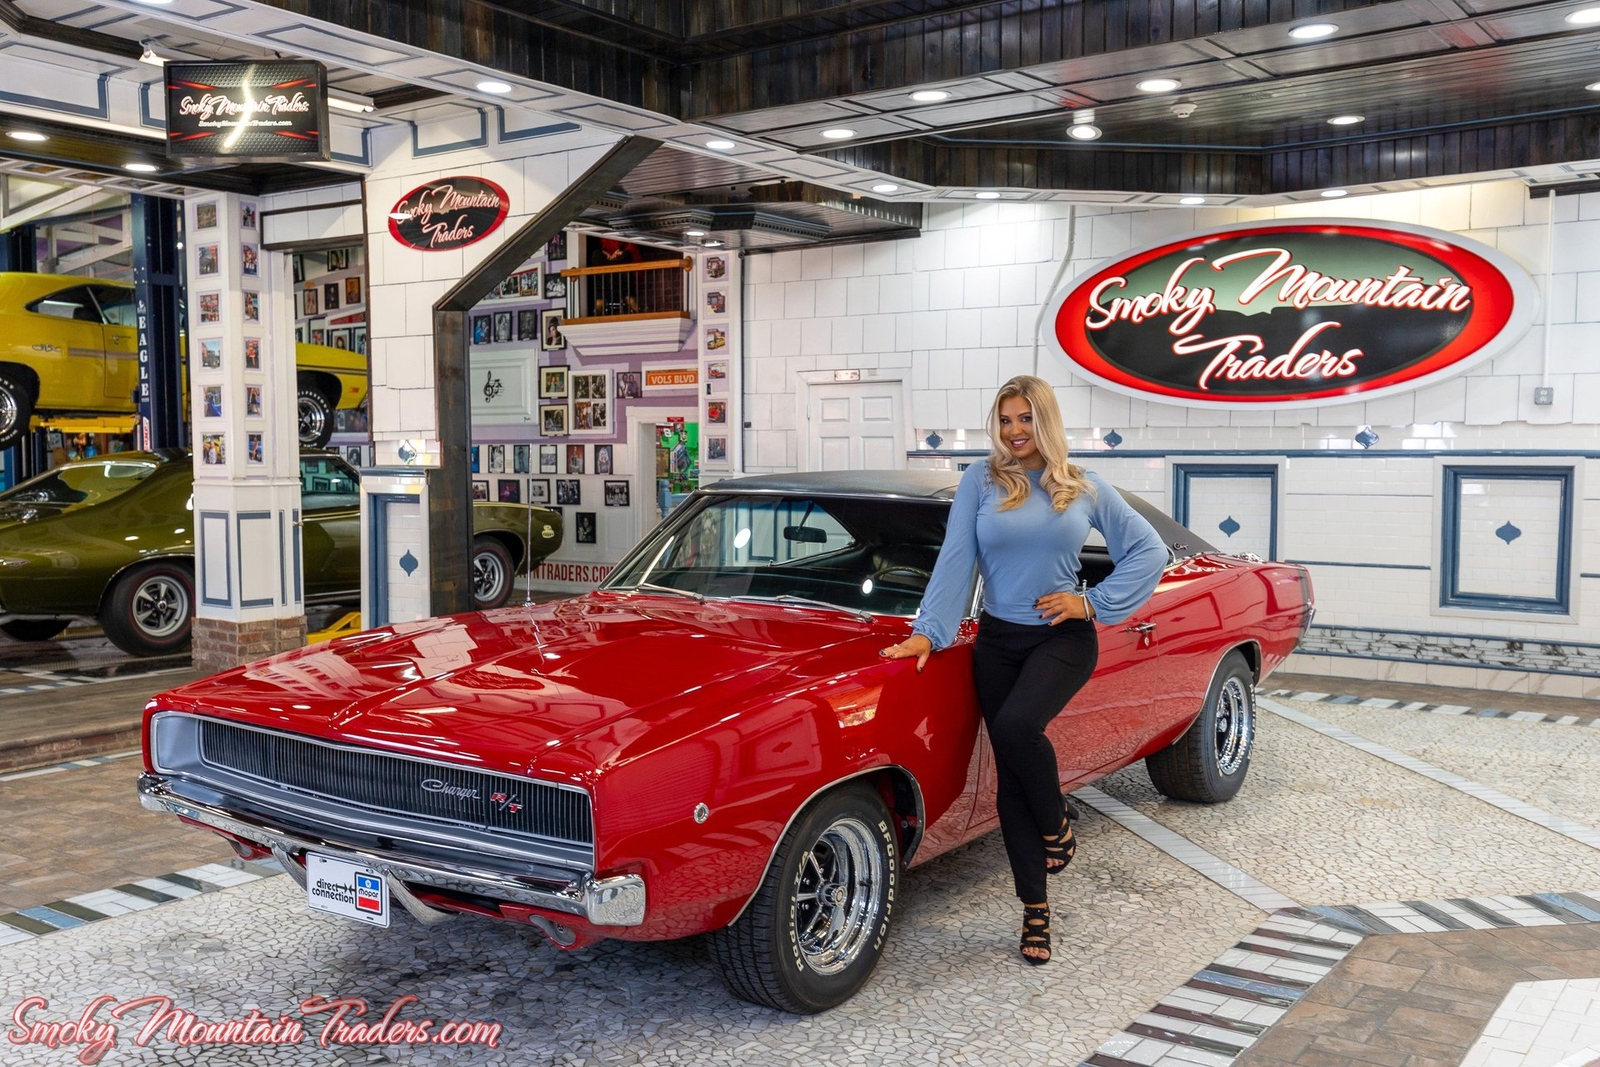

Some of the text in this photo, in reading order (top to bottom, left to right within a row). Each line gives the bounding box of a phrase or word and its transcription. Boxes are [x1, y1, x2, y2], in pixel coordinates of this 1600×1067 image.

[179, 91, 310, 120] Smoky Mouain Traders
[396, 184, 500, 225] Smoky Mountain
[422, 214, 475, 248] Traders
[1084, 247, 1473, 336] Smoky Mountain
[138, 316, 149, 396] EAGLE
[1172, 321, 1365, 391] Traders
[651, 374, 695, 385] VOLS BLVD
[421, 779, 524, 813] Charger R/T
[311, 887, 354, 905] connection
[316, 878, 339, 892] direct
[358, 888, 379, 898] mopar
[789, 896, 804, 971] Radial
